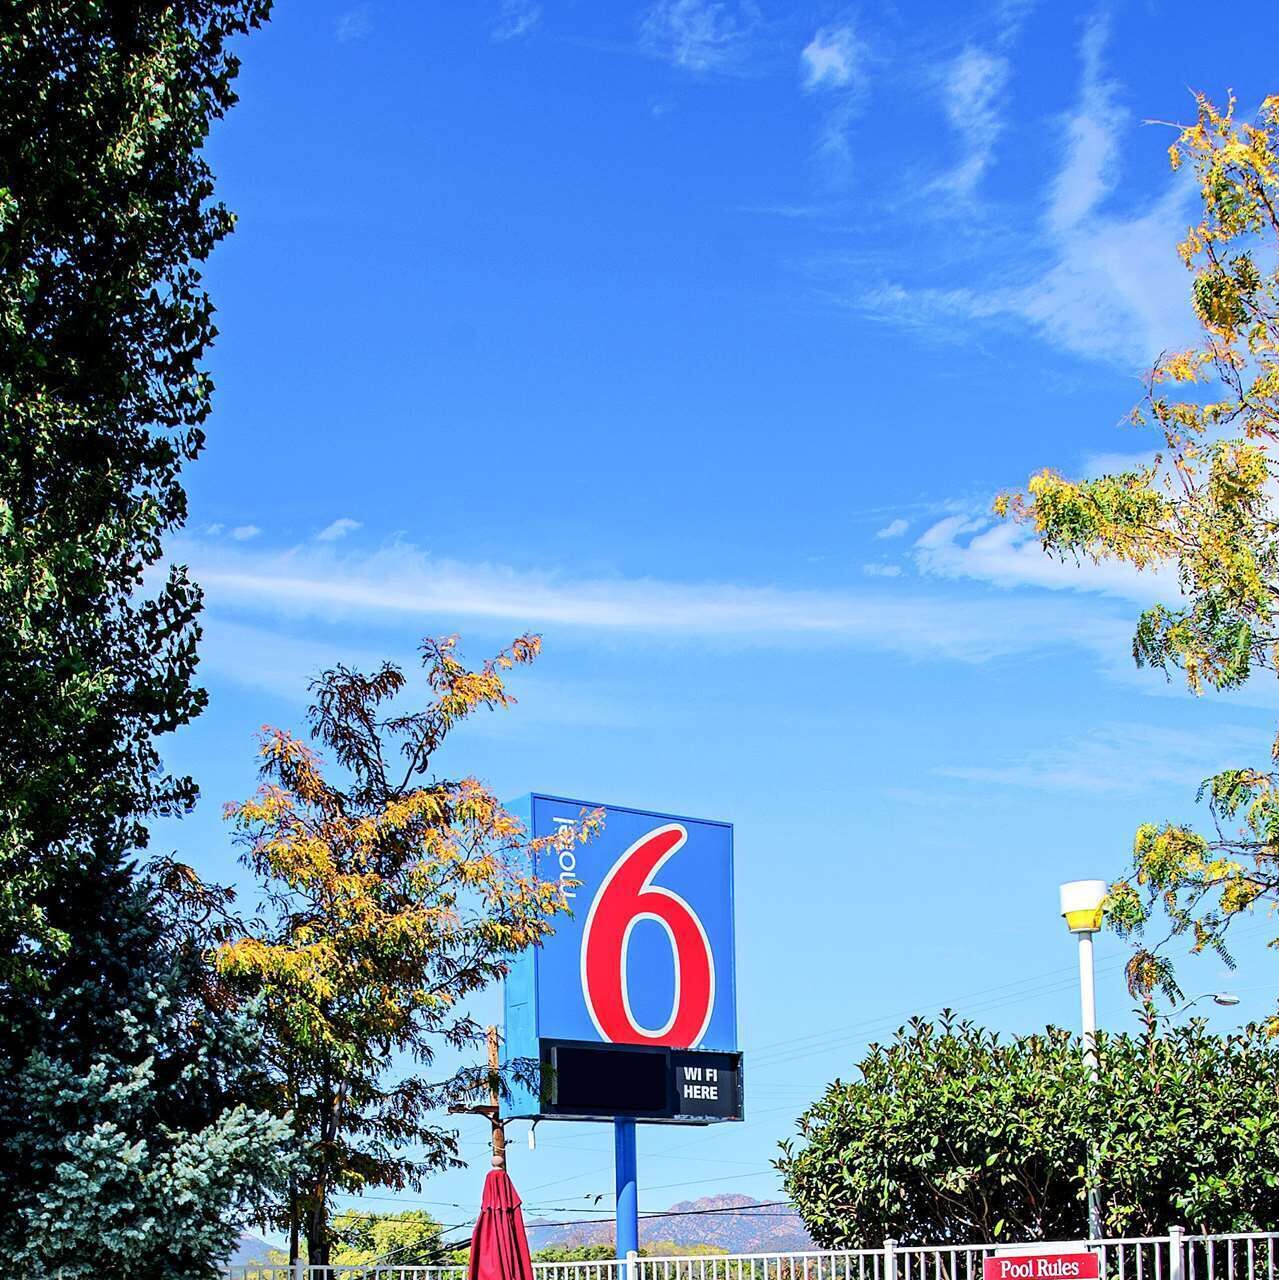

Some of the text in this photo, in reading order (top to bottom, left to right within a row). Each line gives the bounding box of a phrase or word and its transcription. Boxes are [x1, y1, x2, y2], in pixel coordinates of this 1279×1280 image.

[581, 823, 715, 1049] 6
[684, 1067, 718, 1082] WI FI
[684, 1084, 718, 1100] HERE
[1000, 1258, 1079, 1279] Pool Rules
